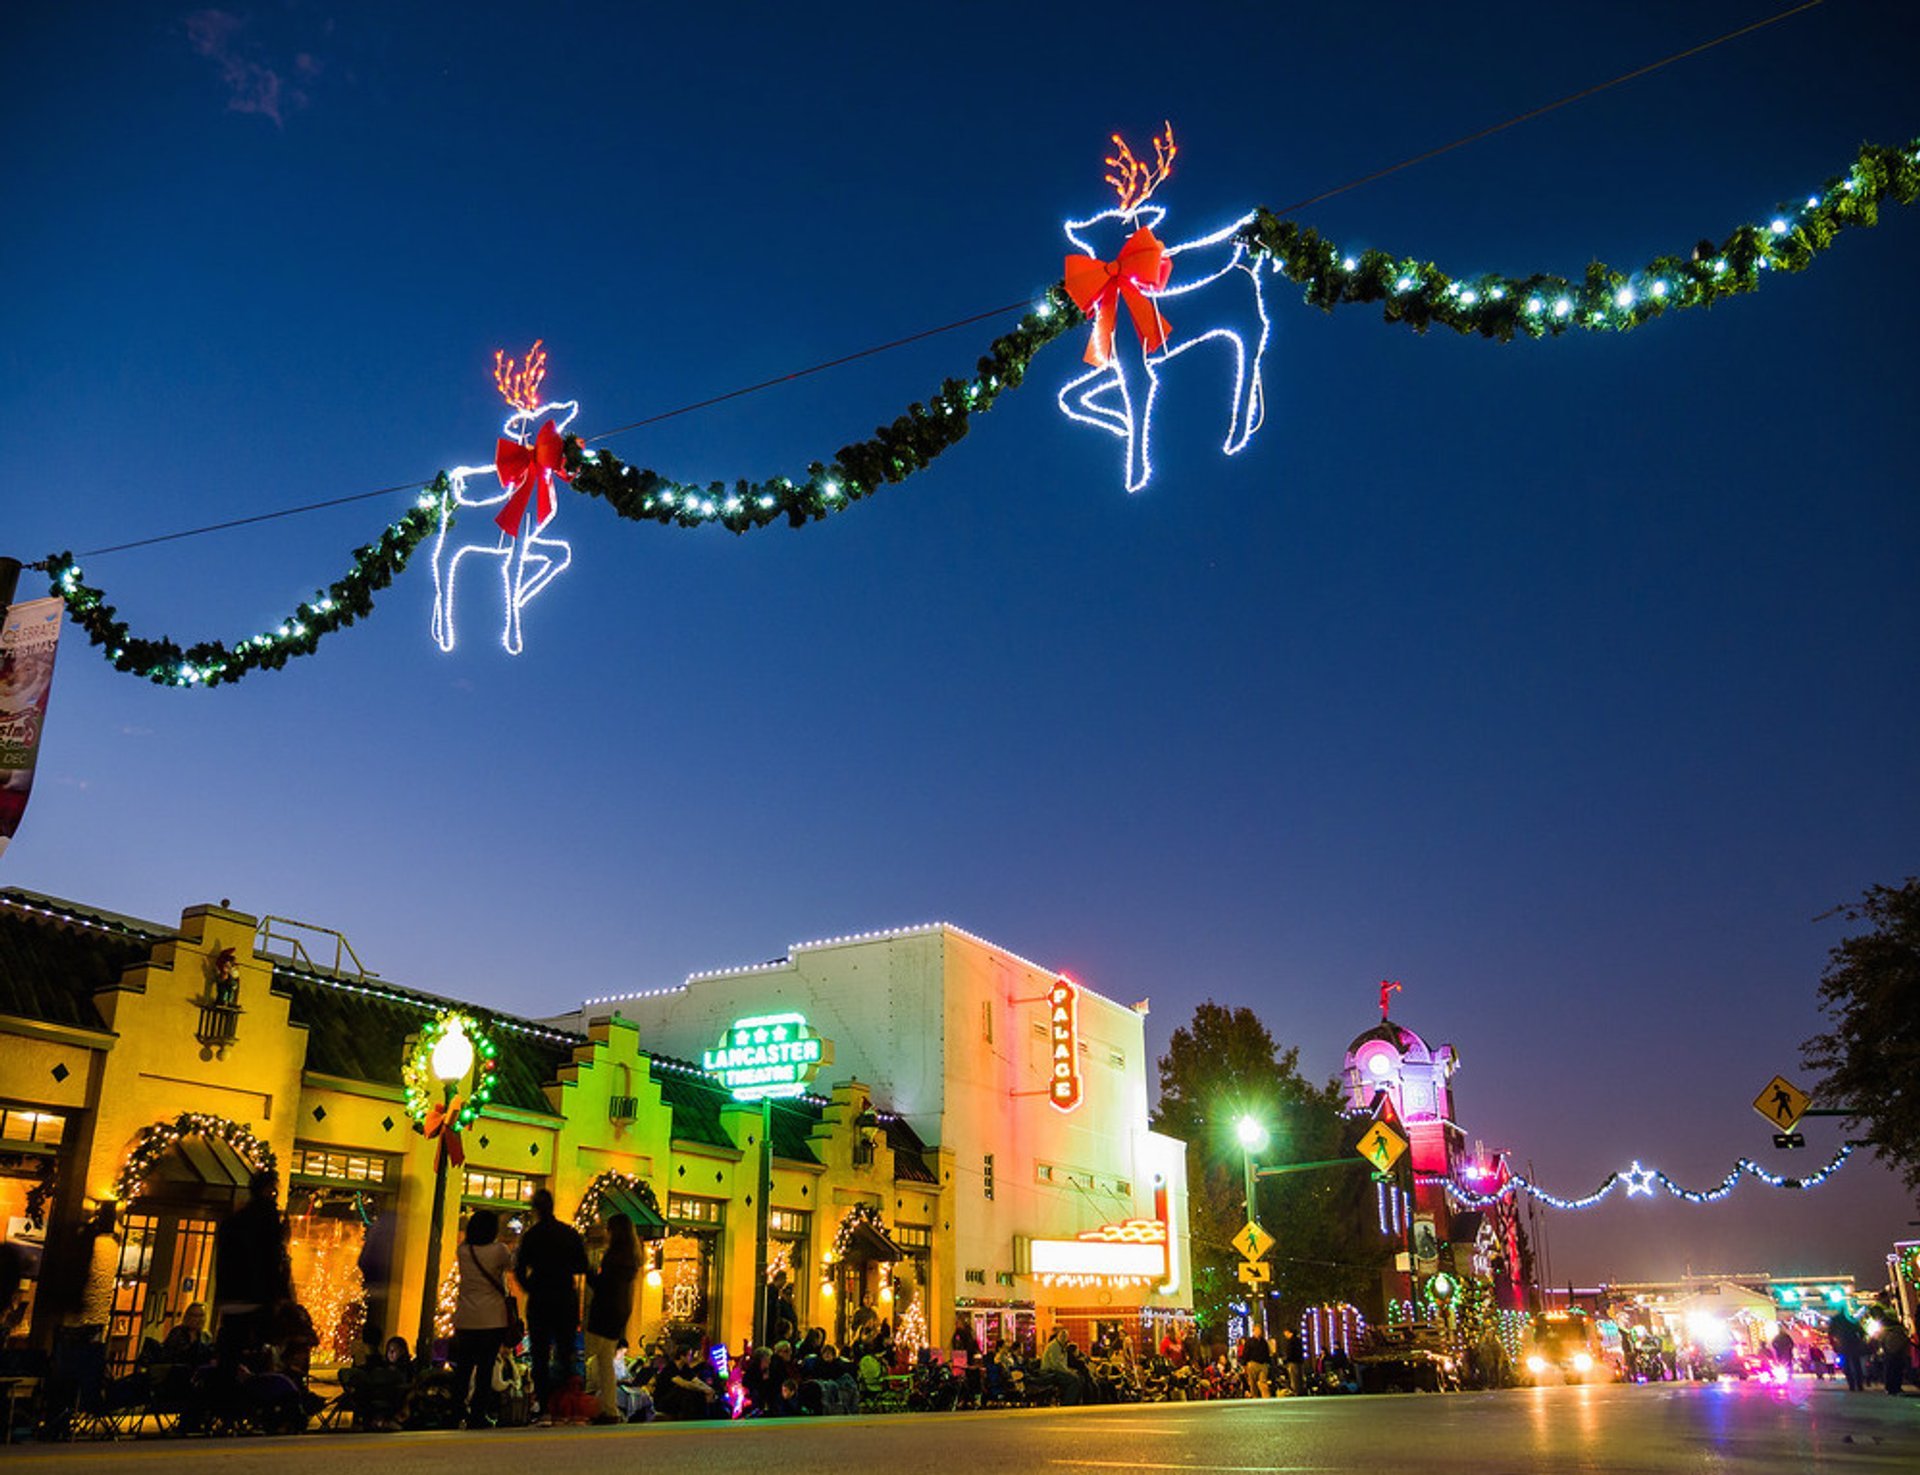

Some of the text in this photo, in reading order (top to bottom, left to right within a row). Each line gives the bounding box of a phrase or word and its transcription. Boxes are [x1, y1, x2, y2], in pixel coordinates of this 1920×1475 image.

[703, 1041, 819, 1070] LANCASTER
[1053, 988, 1071, 1098] PALACE
[726, 1065, 795, 1086] THEATRE
